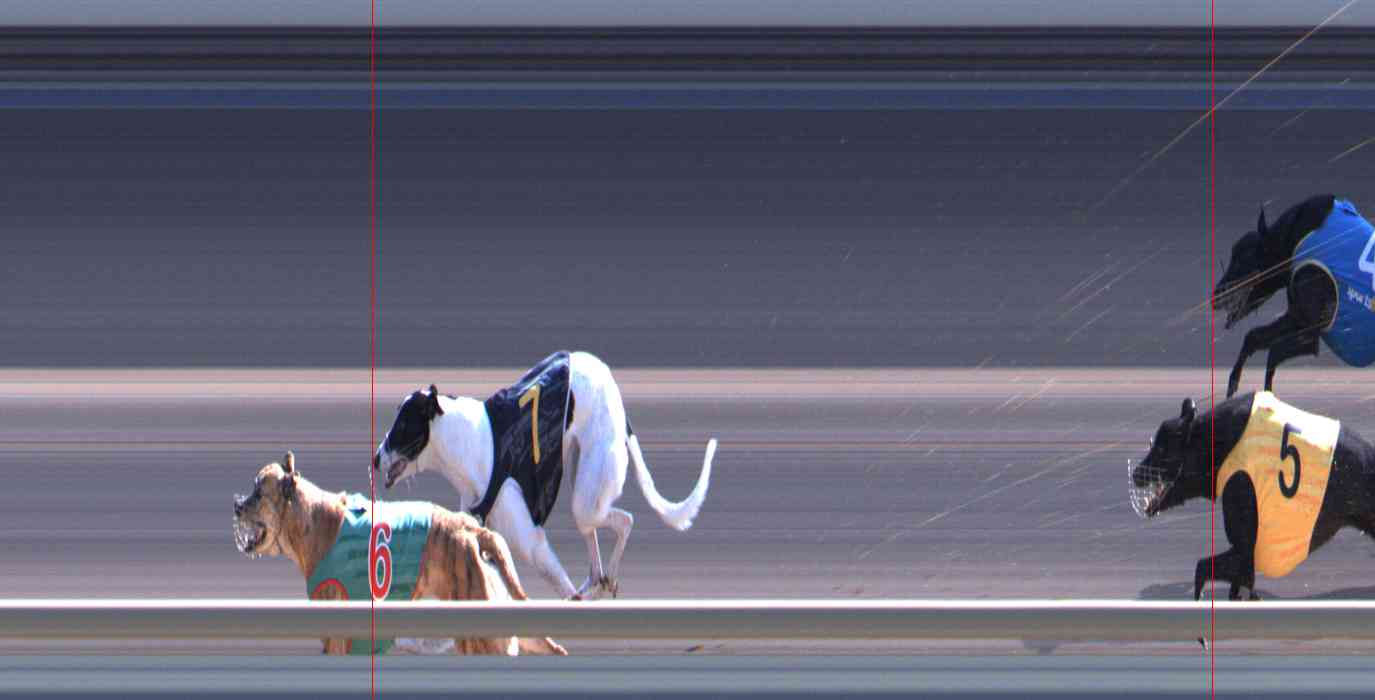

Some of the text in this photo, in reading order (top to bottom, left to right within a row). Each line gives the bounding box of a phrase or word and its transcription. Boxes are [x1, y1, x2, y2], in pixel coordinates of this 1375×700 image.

[518, 383, 541, 465] 7
[1278, 422, 1302, 499] 5
[368, 521, 392, 601] 6
